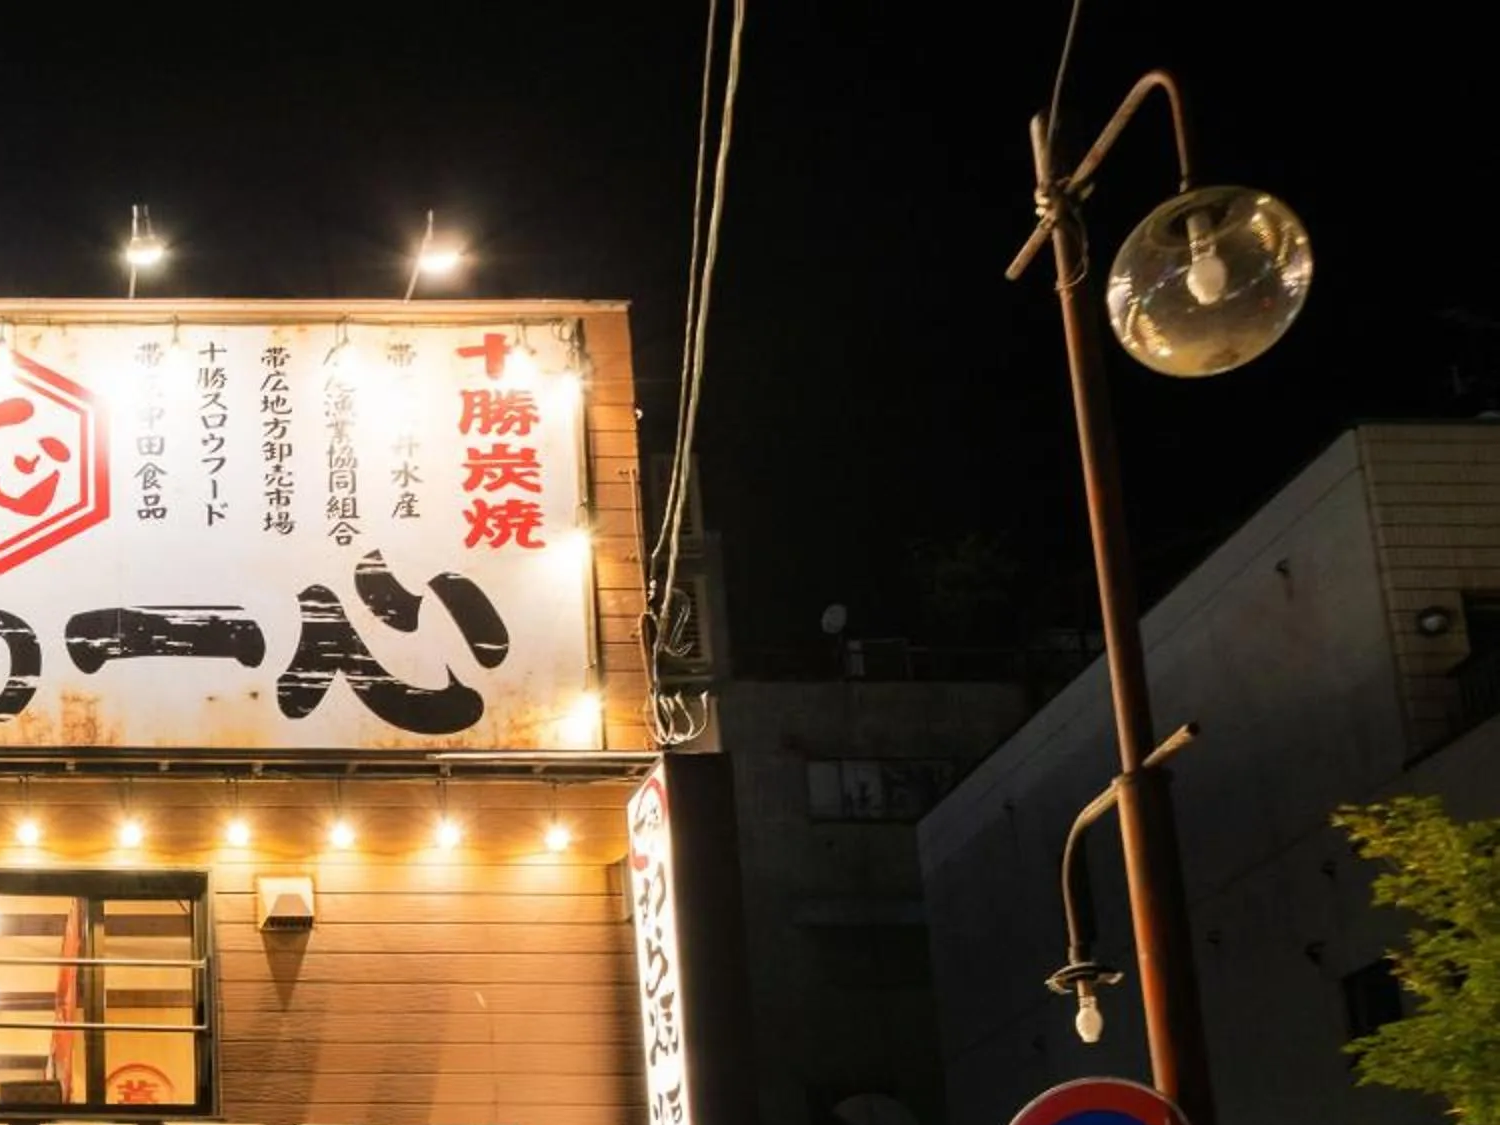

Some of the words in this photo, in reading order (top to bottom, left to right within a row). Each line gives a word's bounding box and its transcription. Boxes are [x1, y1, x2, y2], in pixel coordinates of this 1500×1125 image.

[196, 341, 230, 528] 十勝スロウフード
[259, 345, 296, 537] 帯広地方卸売市場
[455, 332, 548, 551] 十勝炭焼
